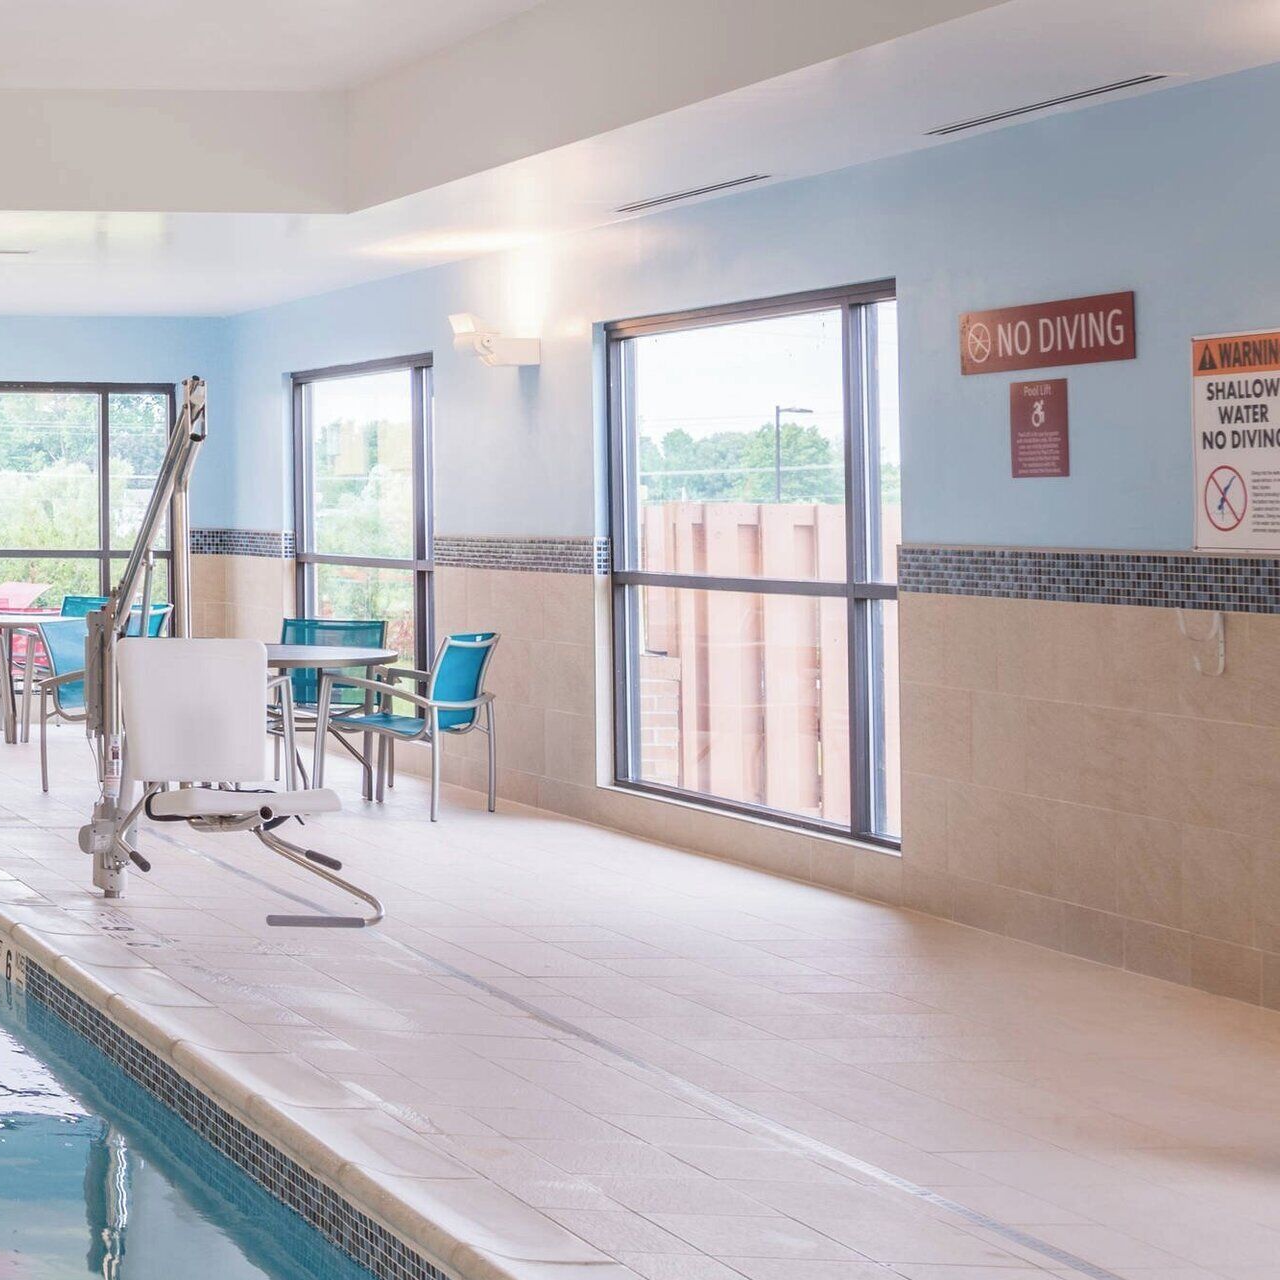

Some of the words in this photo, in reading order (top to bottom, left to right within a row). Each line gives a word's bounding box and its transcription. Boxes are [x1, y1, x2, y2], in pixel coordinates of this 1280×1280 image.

[997, 320, 1031, 358] NO
[1039, 309, 1125, 353] DIVING
[1218, 338, 1280, 369] WARNIN
[1023, 385, 1039, 397] Pool
[1040, 383, 1052, 396] Lift
[1206, 378, 1280, 401] SHALLOW
[1218, 404, 1269, 424] WATER
[1202, 430, 1226, 450] NO
[6, 949, 12, 981] 6
